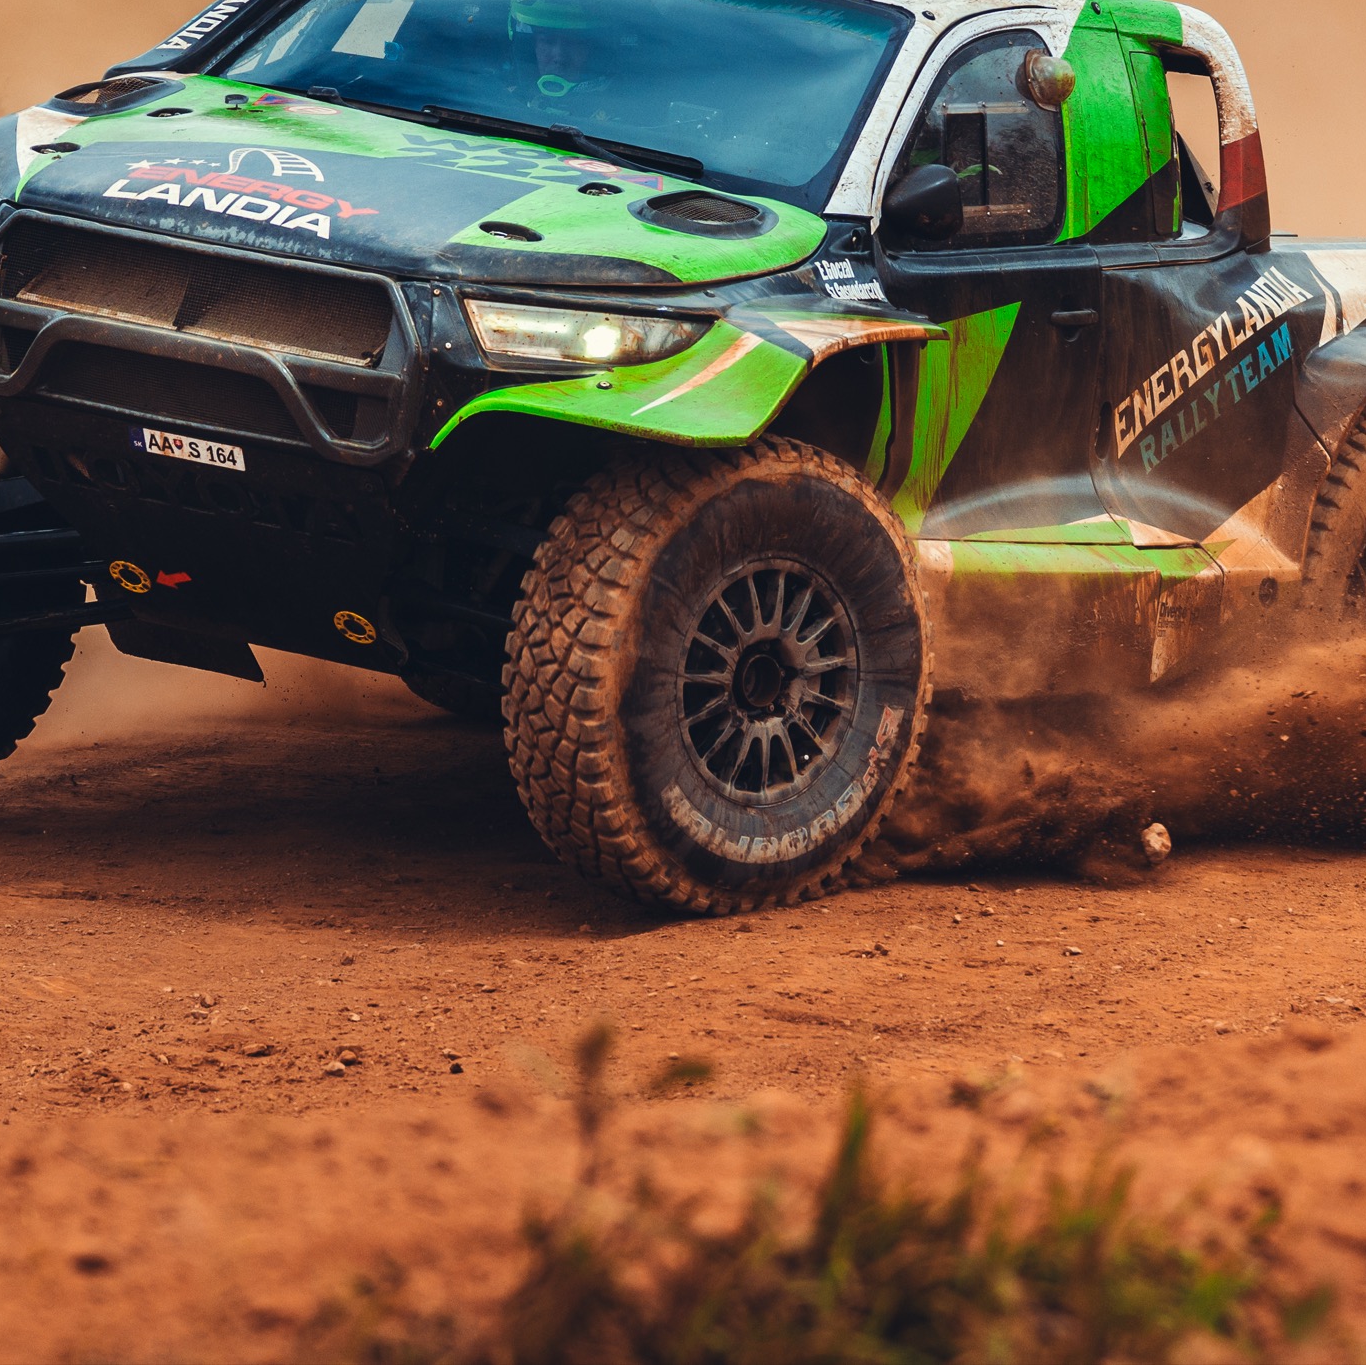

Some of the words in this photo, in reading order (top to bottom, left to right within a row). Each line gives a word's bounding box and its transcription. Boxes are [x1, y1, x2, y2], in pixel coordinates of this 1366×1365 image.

[102, 179, 331, 240] LANDIA
[127, 165, 380, 219] ENERGY
[1112, 265, 1314, 460] ENERGYLANDIA
[1138, 384, 1222, 475] RALLY
[1224, 321, 1295, 405] TEAM
